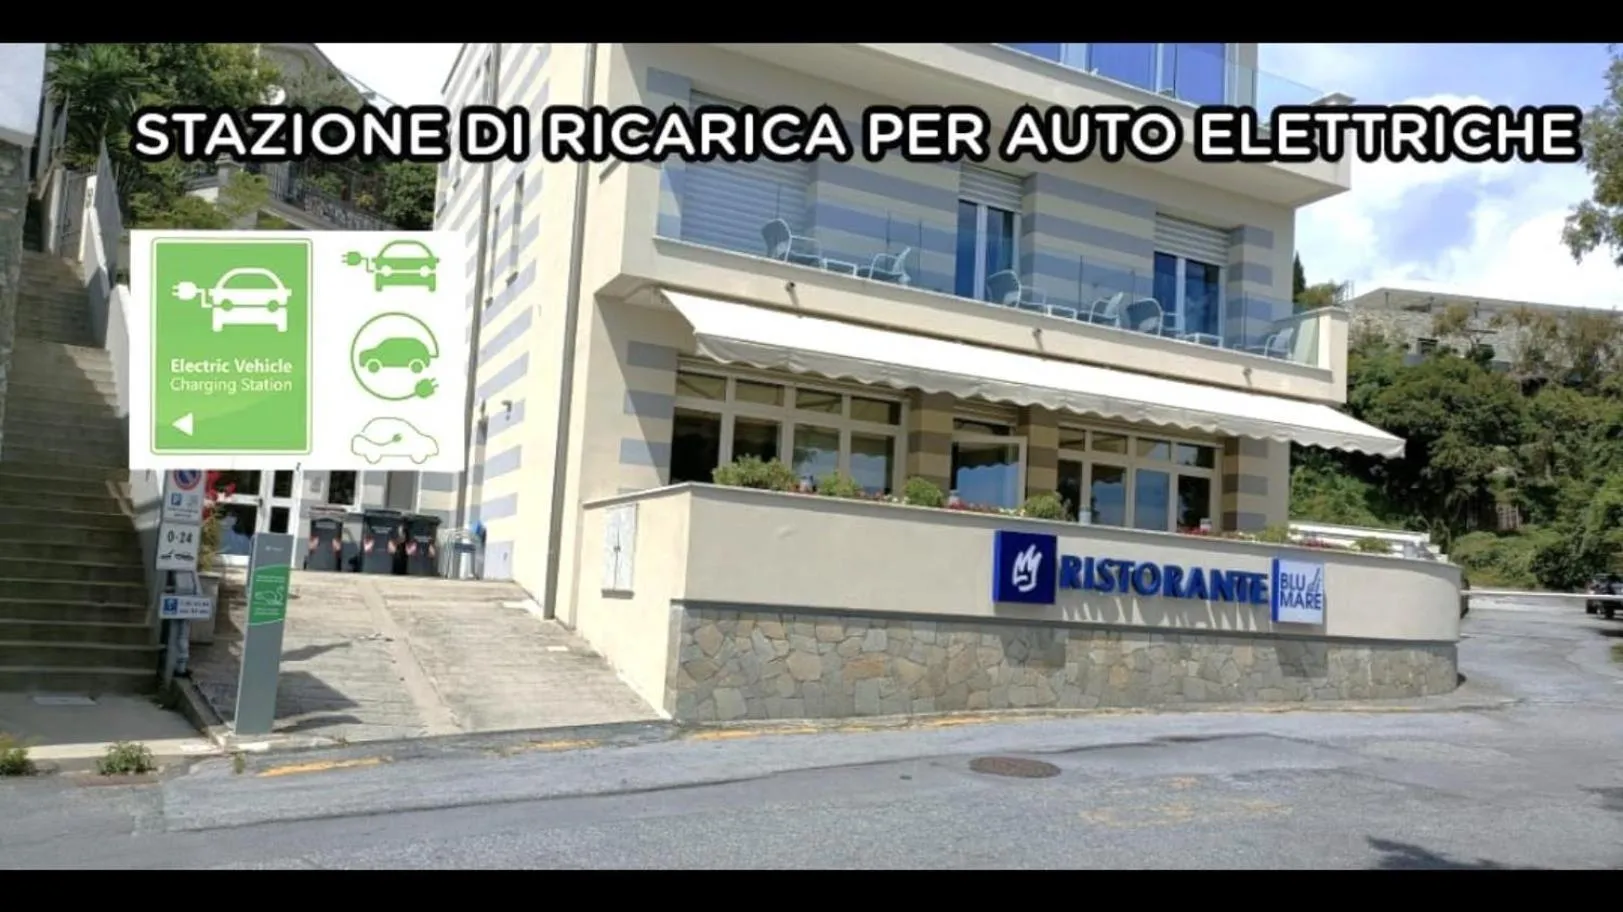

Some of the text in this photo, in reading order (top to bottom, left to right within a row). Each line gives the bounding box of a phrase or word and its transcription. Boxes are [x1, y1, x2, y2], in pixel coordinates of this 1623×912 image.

[1060, 555, 1269, 605] RISTORANTE
[1280, 572, 1306, 591] BLU
[1280, 590, 1322, 611] MARE
